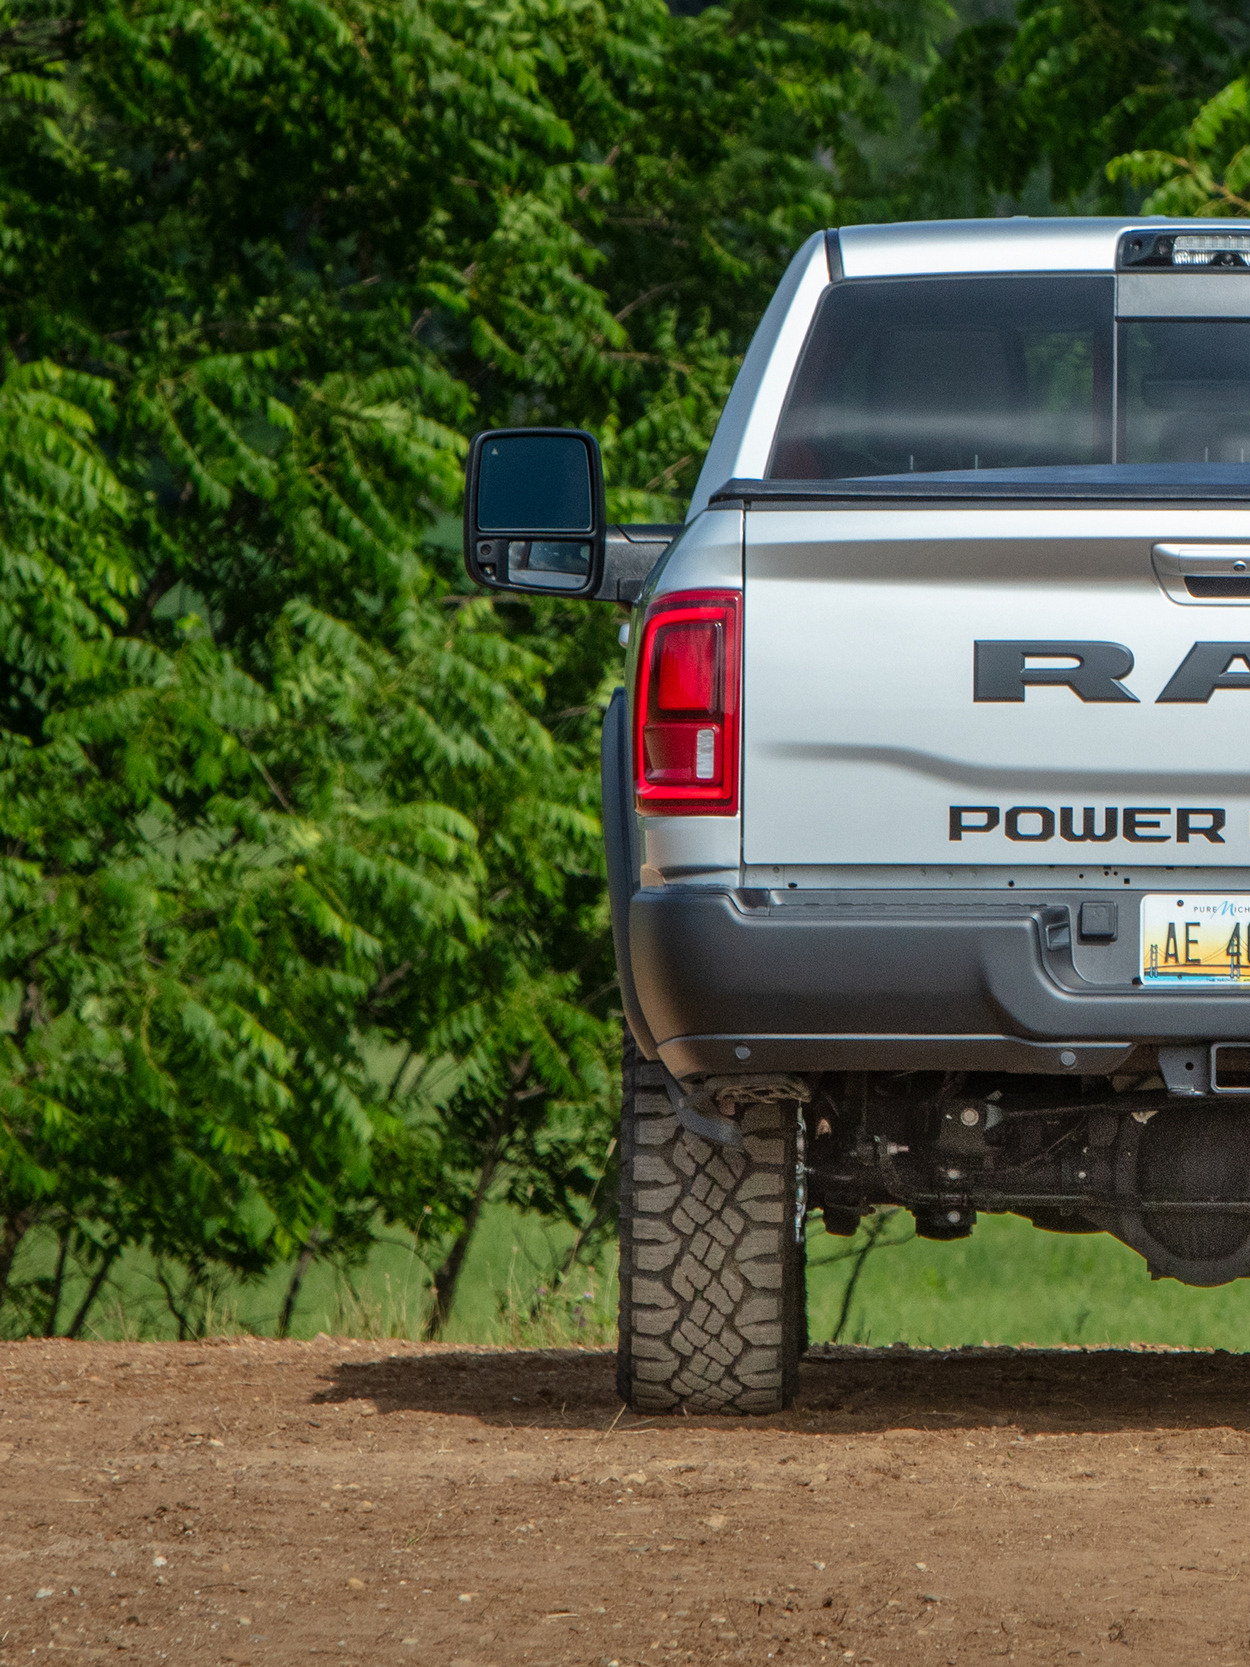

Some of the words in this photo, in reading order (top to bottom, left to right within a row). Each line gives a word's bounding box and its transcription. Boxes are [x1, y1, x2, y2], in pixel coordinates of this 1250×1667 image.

[949, 806, 1226, 843] POWER
[1193, 906, 1217, 914] PURE
[1164, 922, 1201, 964] AE
